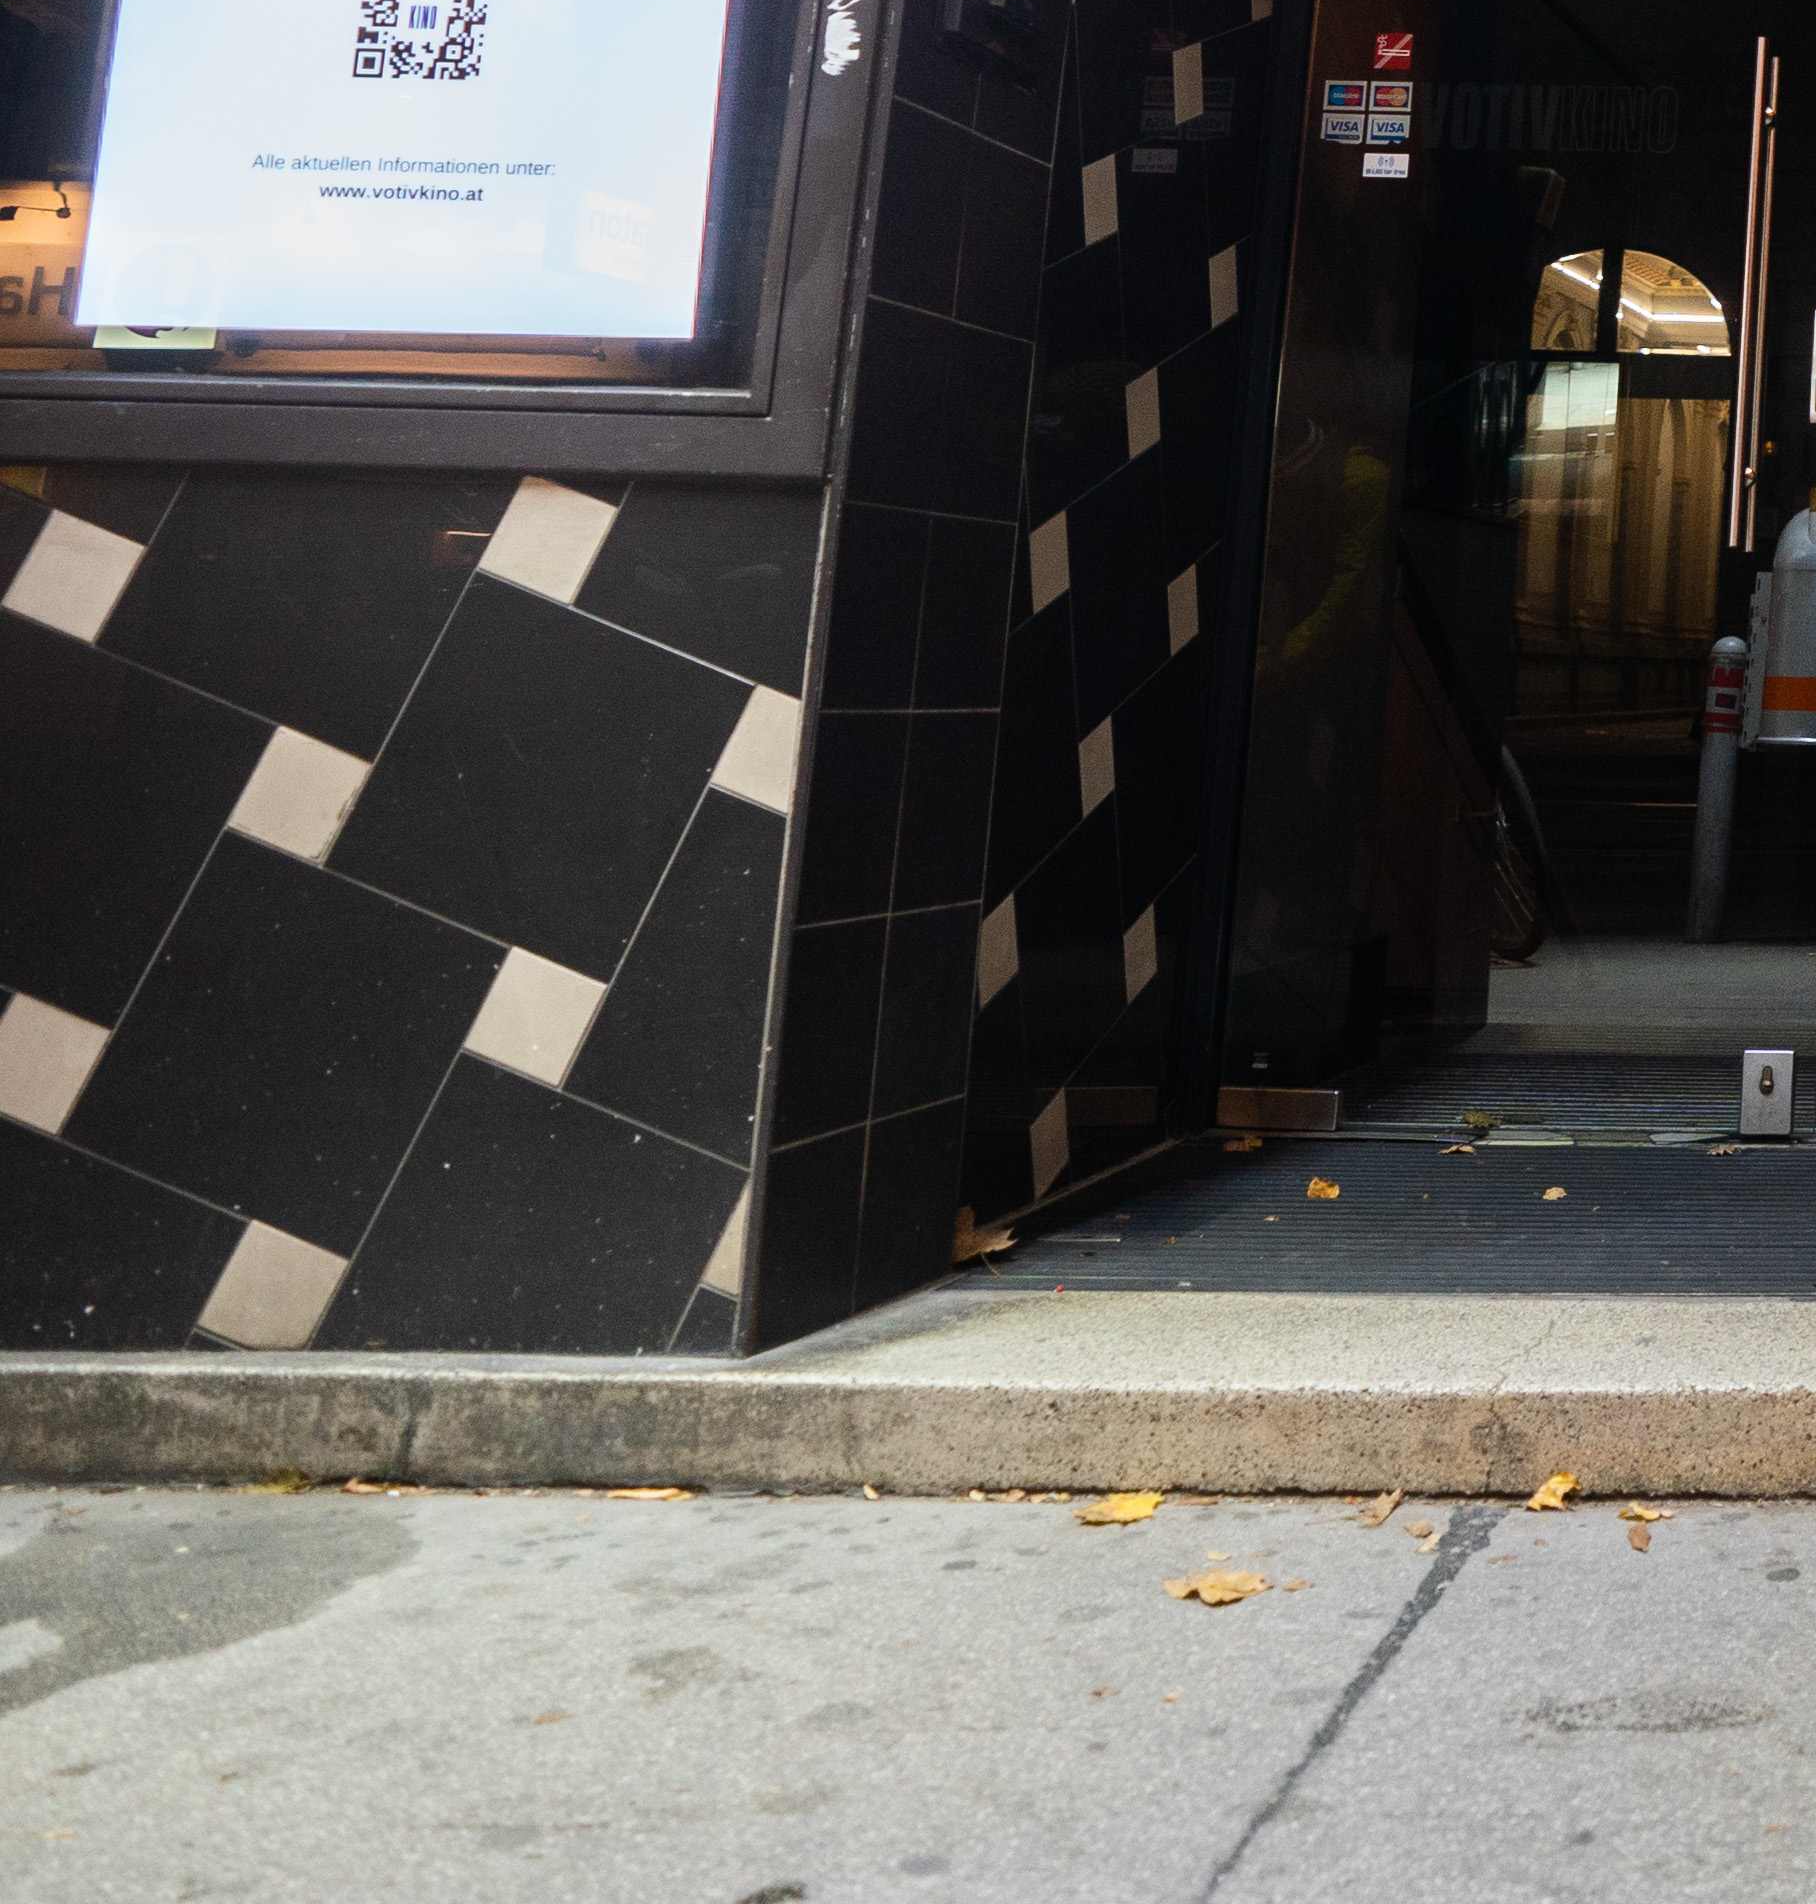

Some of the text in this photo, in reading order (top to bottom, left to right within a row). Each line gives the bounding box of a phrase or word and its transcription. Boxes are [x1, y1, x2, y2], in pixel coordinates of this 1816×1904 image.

[407, 5, 438, 30] KINO
[1331, 120, 1360, 133] VISA
[1375, 122, 1405, 133] VISA
[251, 153, 555, 175] Alle aktuellen Informationen unter:
[319, 185, 483, 201] www.votivkino.at
